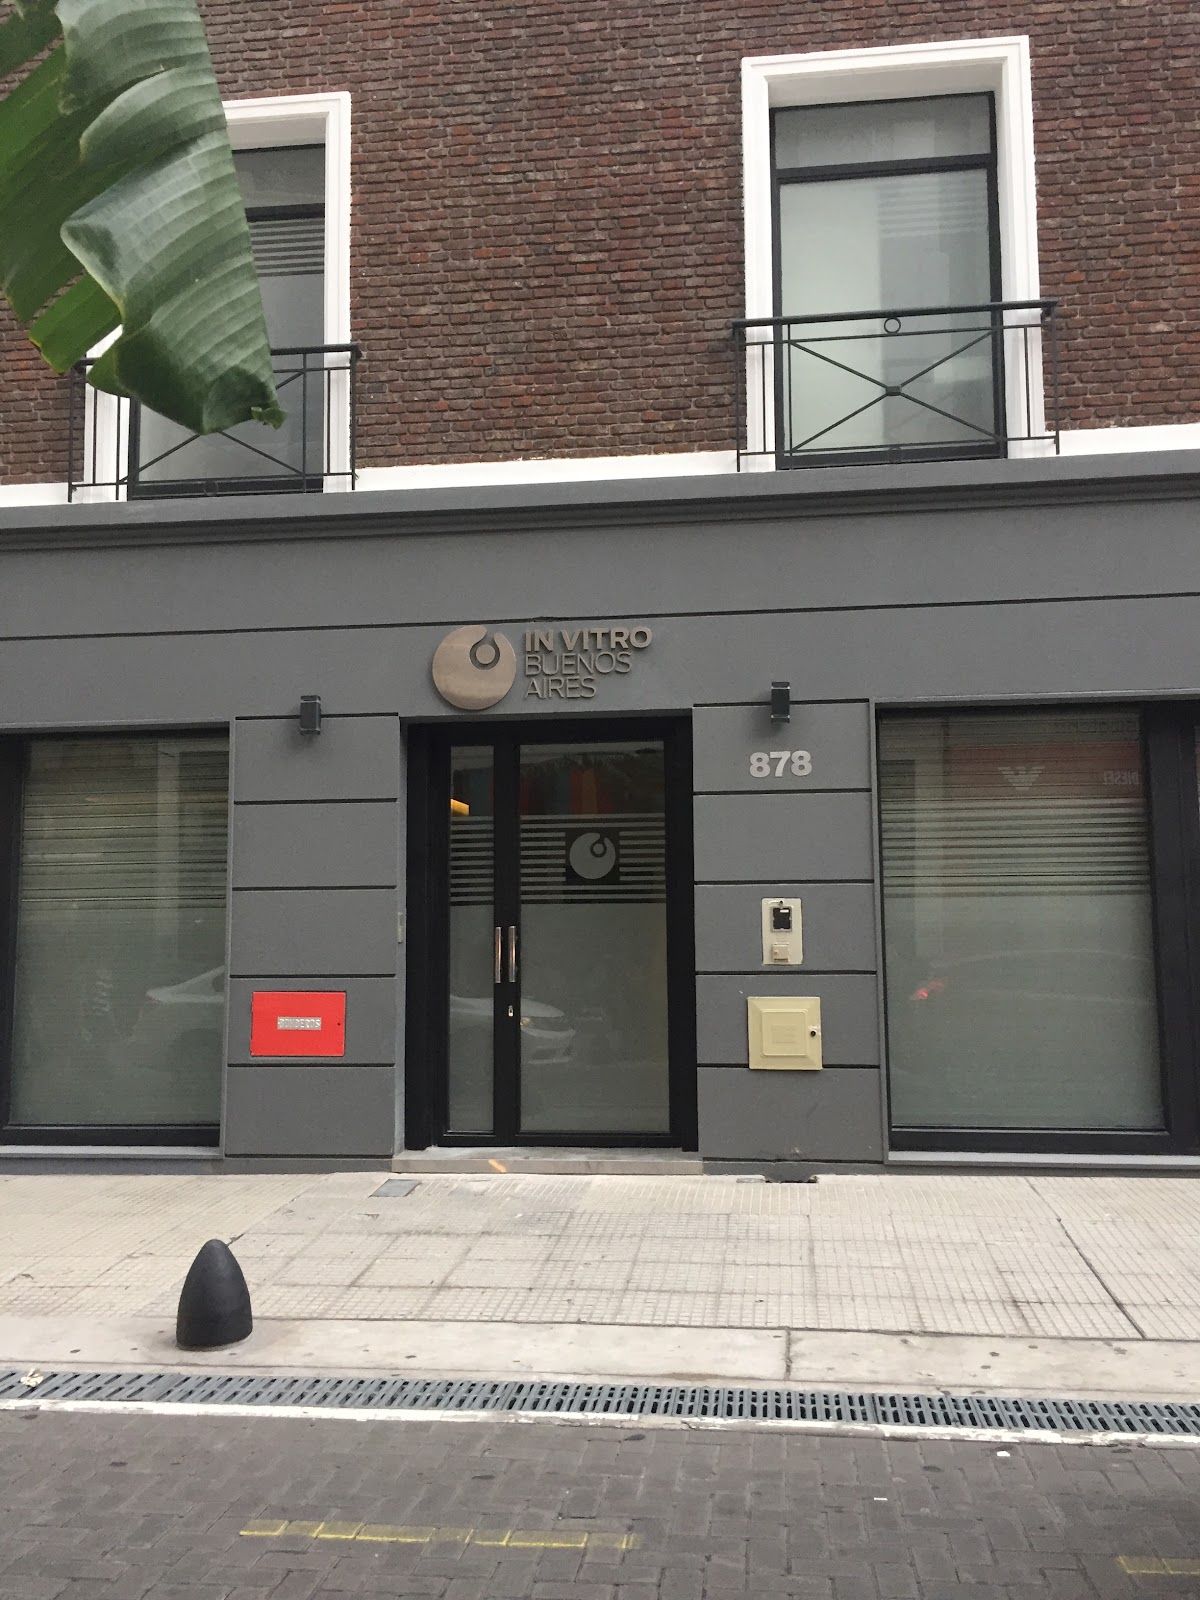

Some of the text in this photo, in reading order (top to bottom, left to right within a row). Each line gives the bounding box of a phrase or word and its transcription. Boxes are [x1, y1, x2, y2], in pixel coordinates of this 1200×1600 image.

[525, 626, 652, 651] IN VITRO
[525, 651, 632, 675] BUENOS
[524, 677, 597, 699] AIRES
[750, 750, 812, 777] 878
